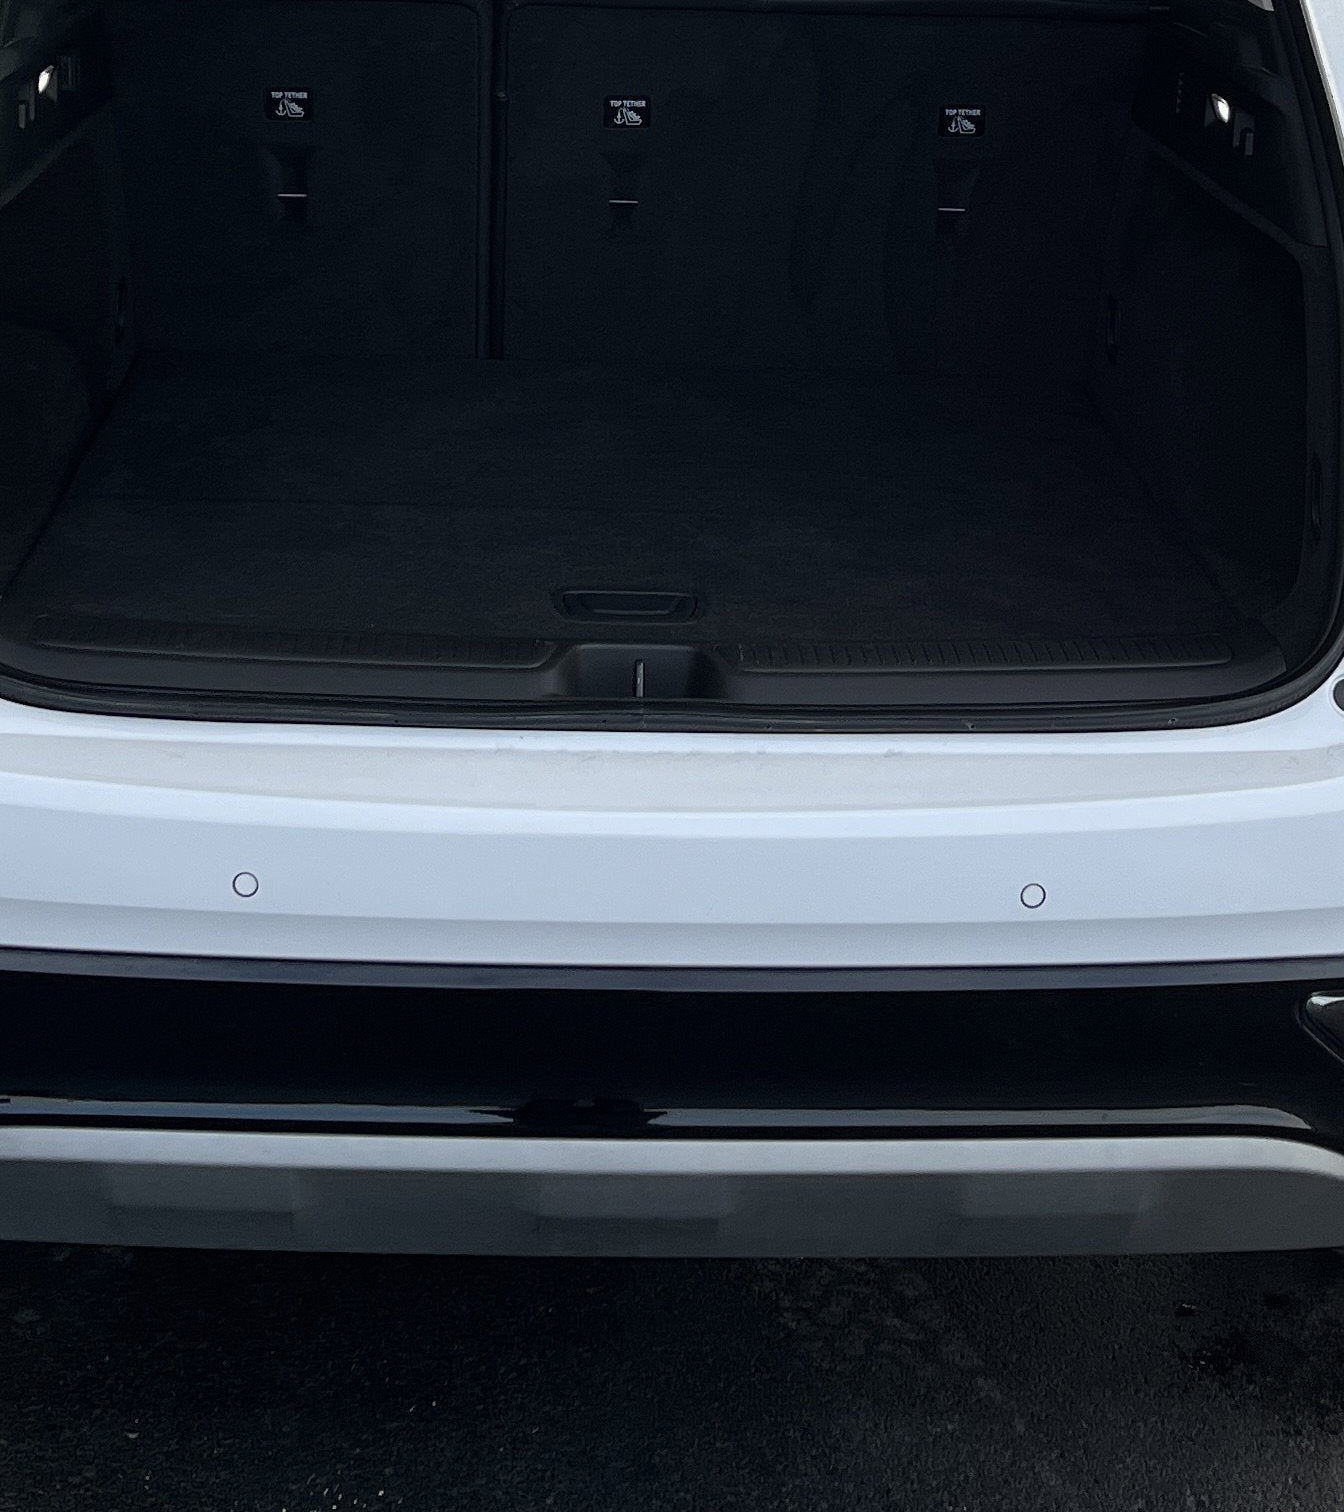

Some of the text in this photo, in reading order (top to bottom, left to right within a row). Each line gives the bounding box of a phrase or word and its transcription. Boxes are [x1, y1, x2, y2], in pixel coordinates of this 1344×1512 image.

[271, 91, 308, 99] TOP TETHER
[945, 108, 981, 116] TOP TETHER
